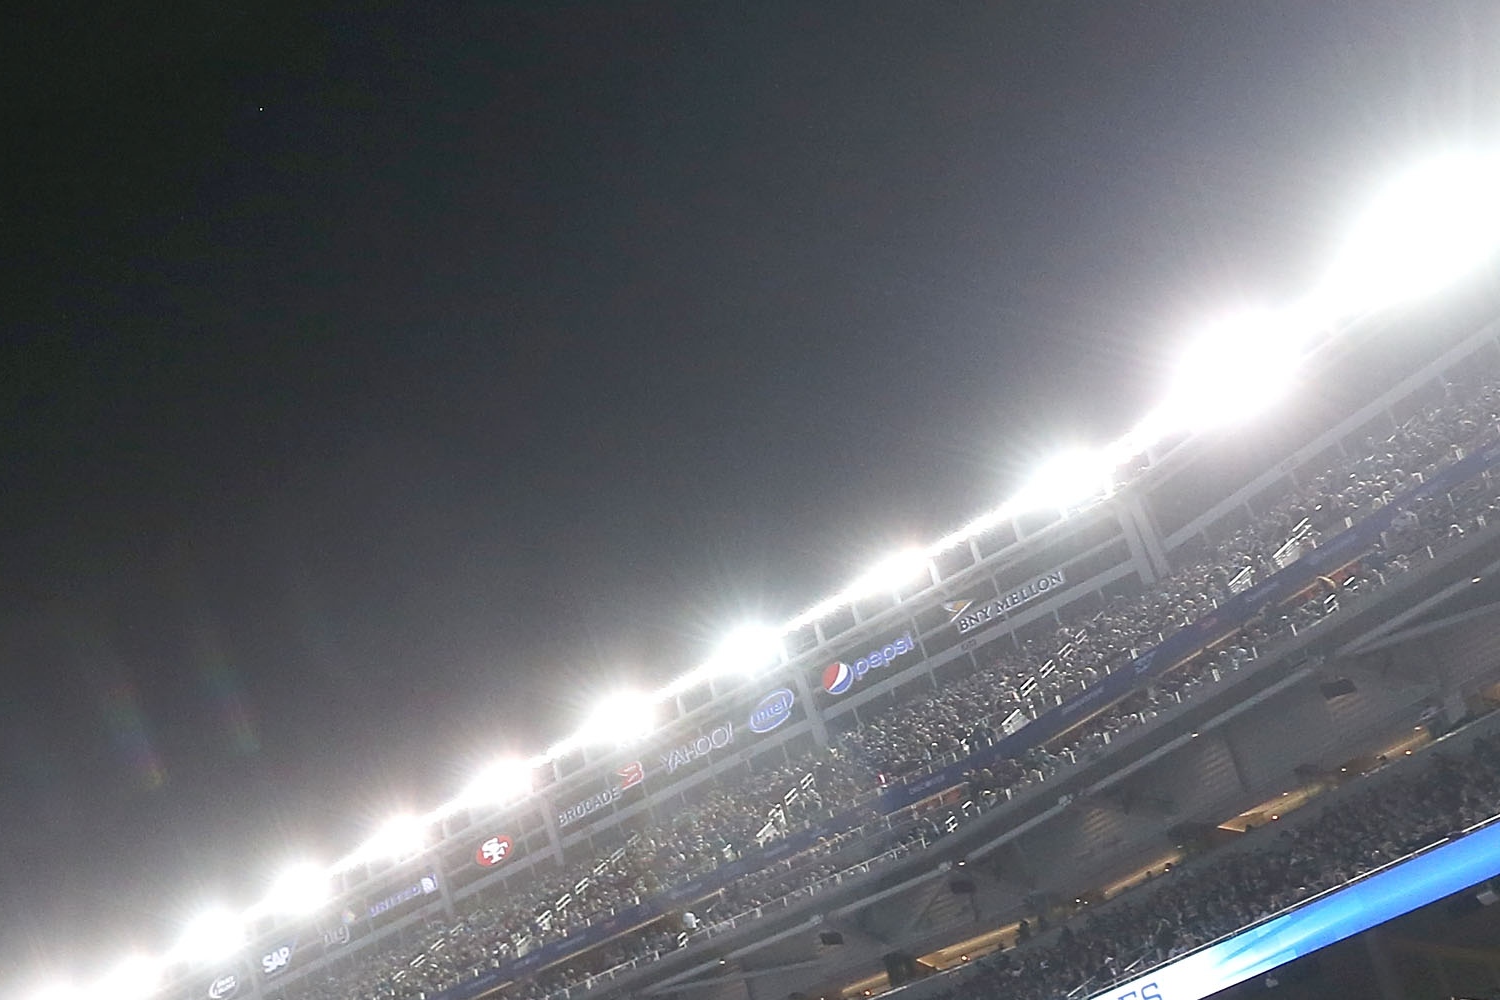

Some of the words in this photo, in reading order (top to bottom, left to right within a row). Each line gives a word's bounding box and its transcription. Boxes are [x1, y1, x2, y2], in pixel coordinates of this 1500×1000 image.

[958, 605, 992, 633] BNY
[994, 570, 1066, 615] MELLON
[853, 630, 915, 681] pepsi
[558, 785, 622, 828] BROCADE
[261, 946, 290, 974] SAP
